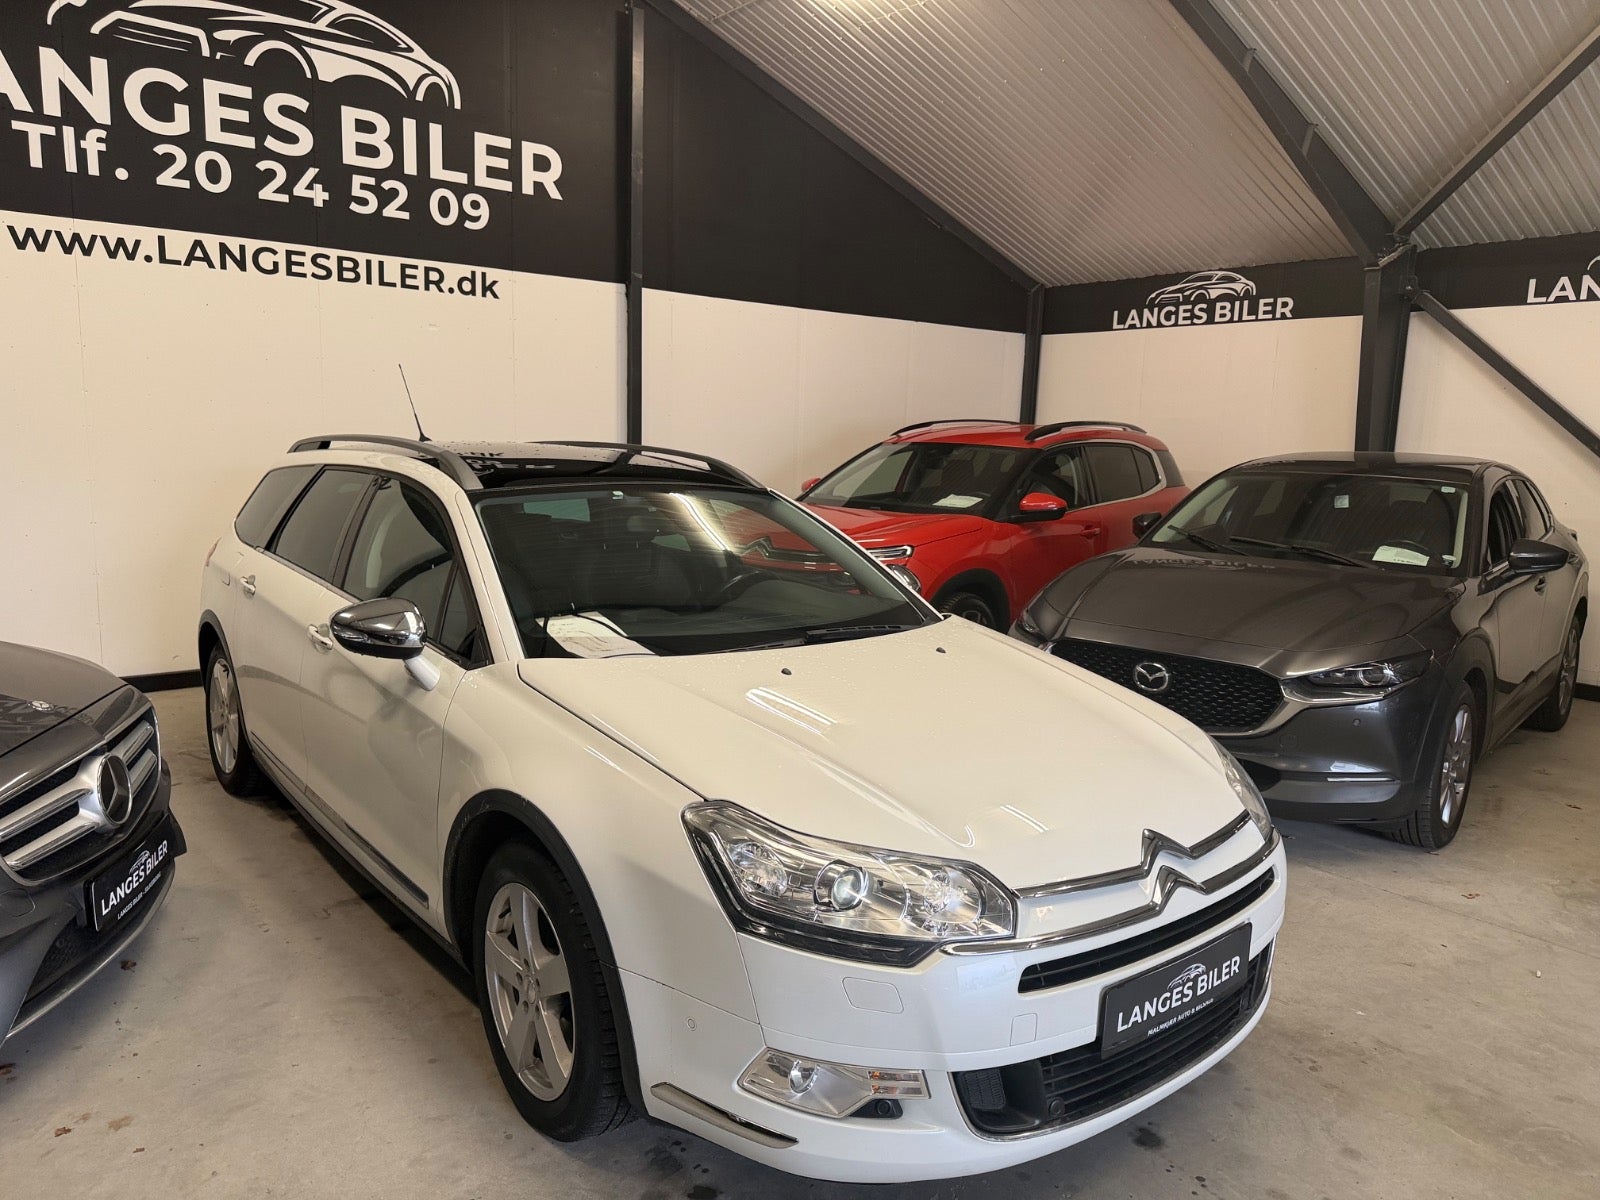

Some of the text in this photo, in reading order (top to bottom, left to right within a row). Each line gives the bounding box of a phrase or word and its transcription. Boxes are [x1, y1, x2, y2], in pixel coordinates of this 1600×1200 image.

[11, 119, 490, 230] Tlf. 20 24 52 09
[340, 104, 564, 201] BILER
[6, 224, 500, 300] www.LANGESBILER.dk
[1112, 296, 1294, 330] LANGES BILER
[101, 865, 146, 916] LANGES
[146, 840, 168, 876] BILER
[1116, 955, 1241, 1033] LANGES BILER
